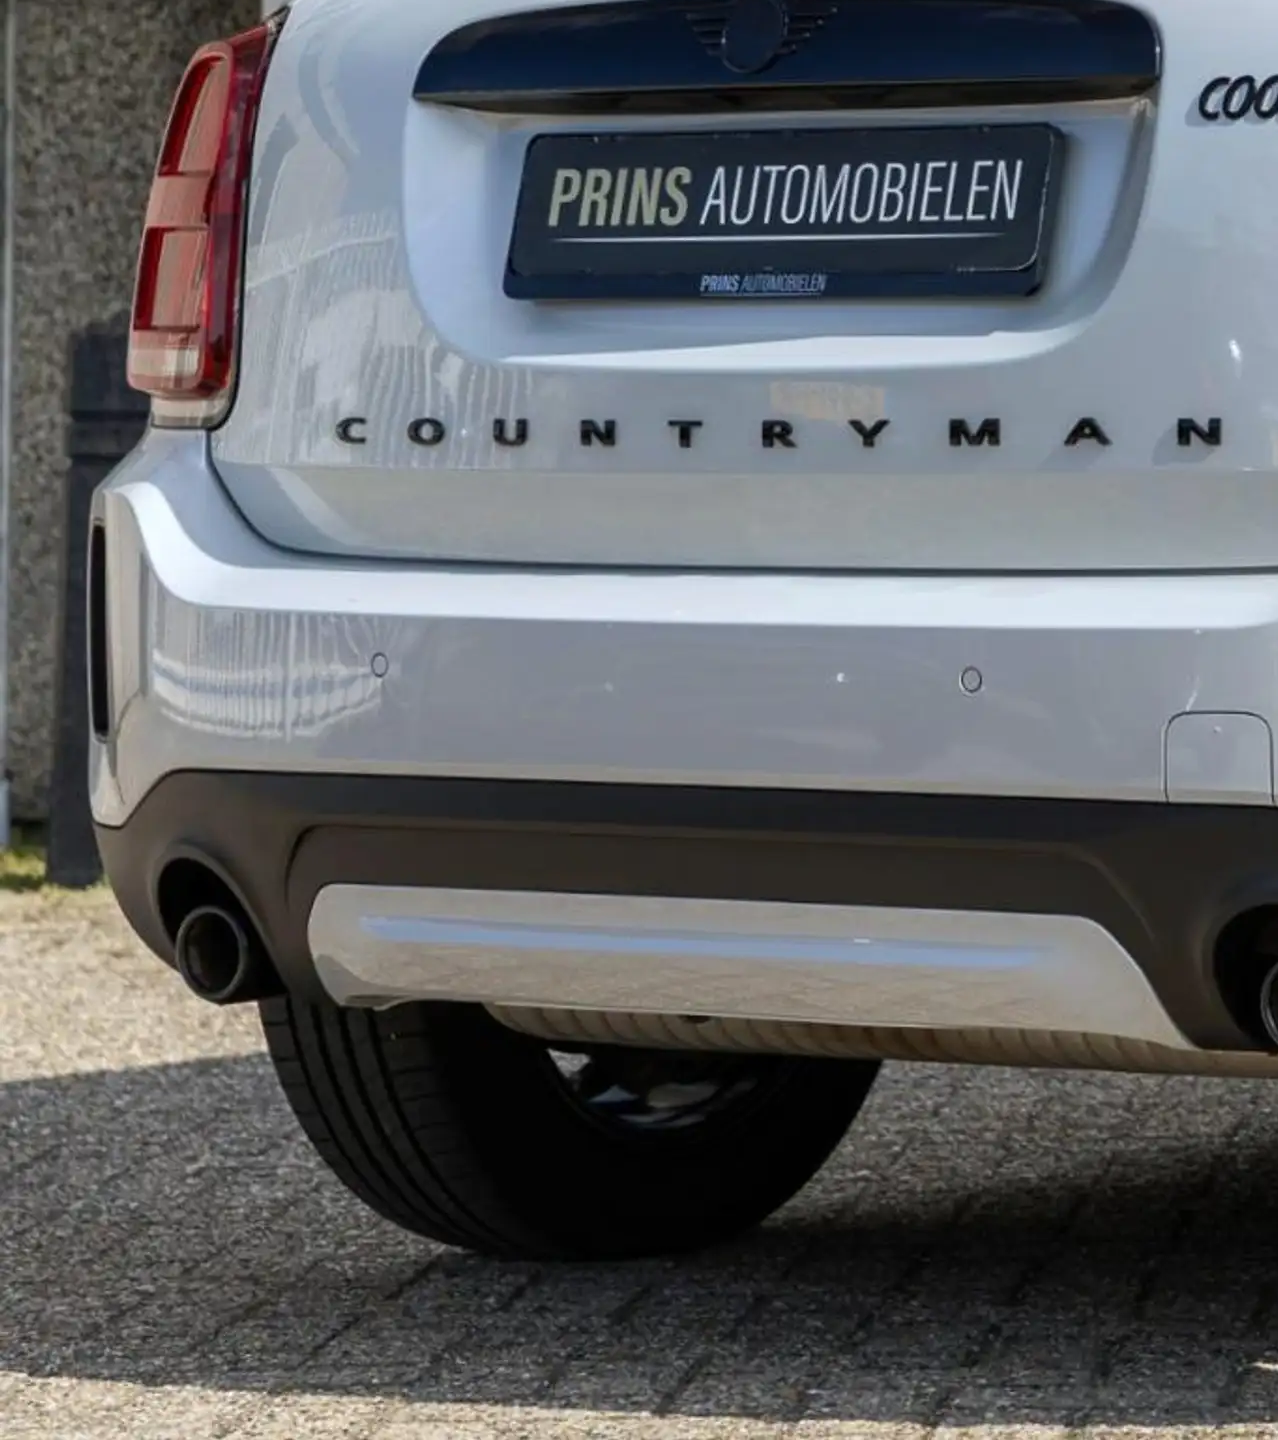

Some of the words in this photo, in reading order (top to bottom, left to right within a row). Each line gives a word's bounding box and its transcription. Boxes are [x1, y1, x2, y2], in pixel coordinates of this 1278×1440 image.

[547, 165, 692, 228] PRINS
[699, 159, 1023, 227] AUTOMOBIELEN
[700, 273, 740, 293] PRINS
[335, 416, 1222, 448] COUNTRYMAN
